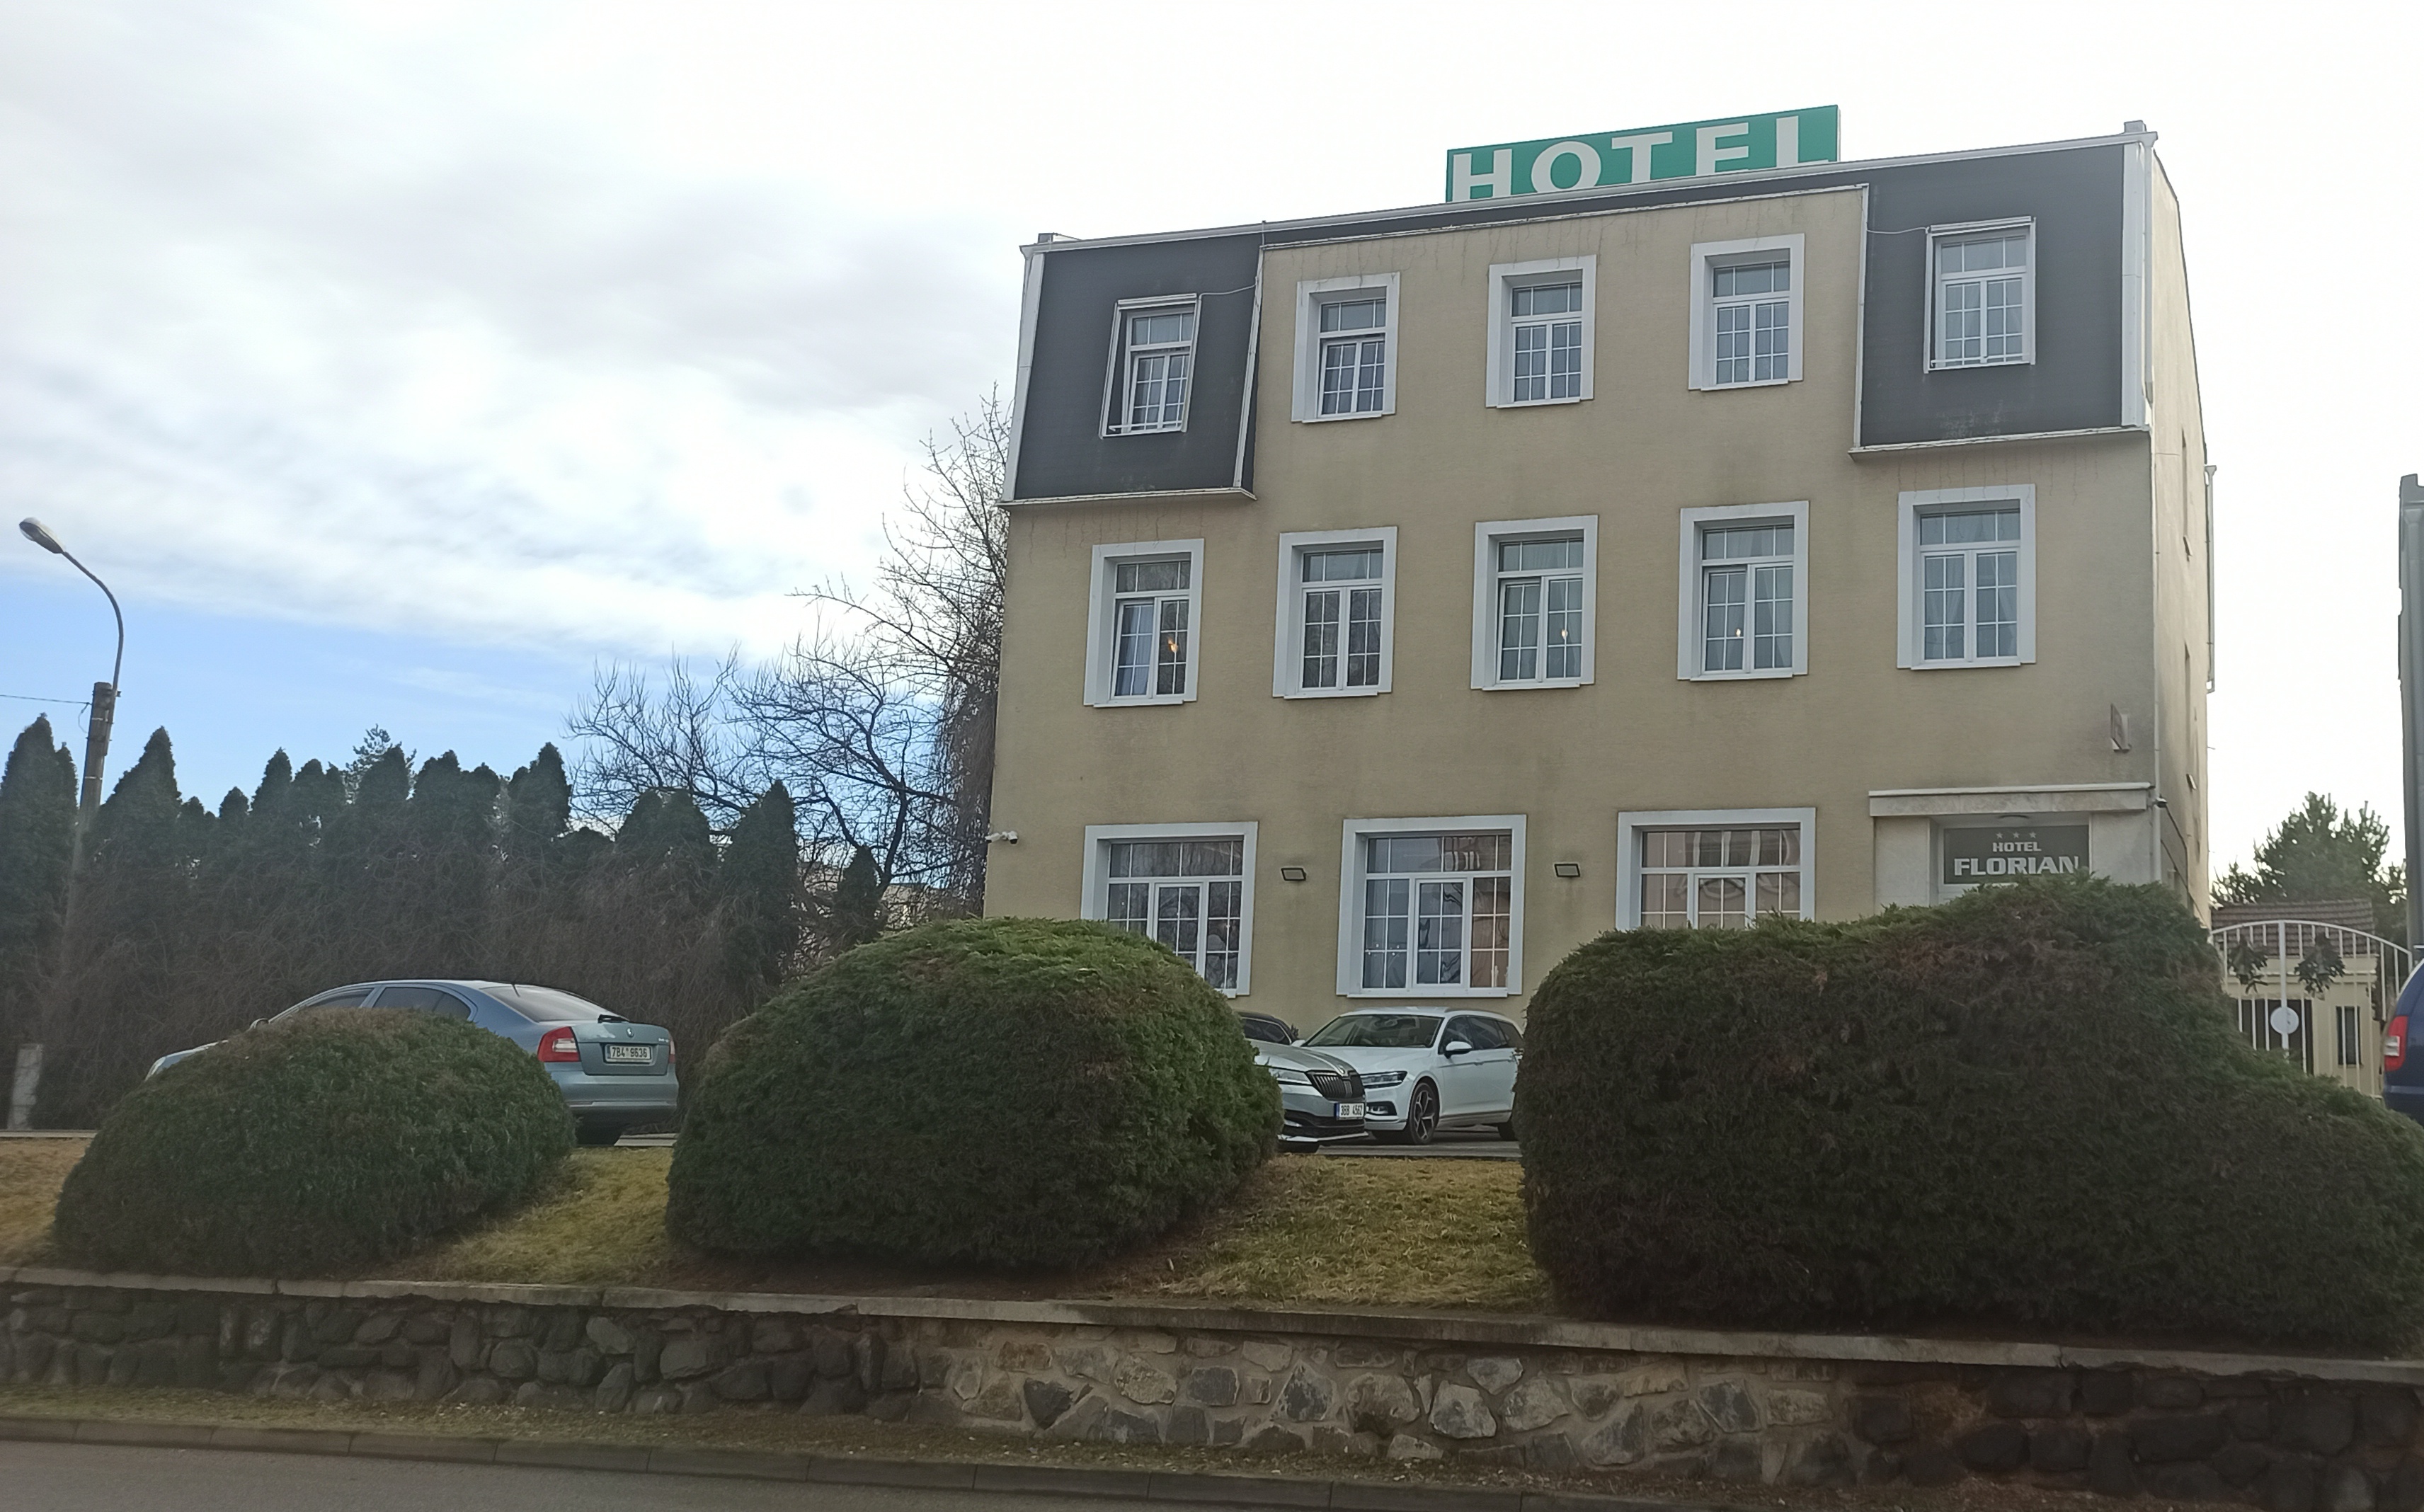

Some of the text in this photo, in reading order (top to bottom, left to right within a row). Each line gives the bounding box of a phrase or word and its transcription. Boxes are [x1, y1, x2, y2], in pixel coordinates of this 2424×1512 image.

[1452, 115, 1829, 202] HOTEL
[1992, 842, 2041, 852] HOTEL
[1954, 856, 2079, 876] FLORIAN
